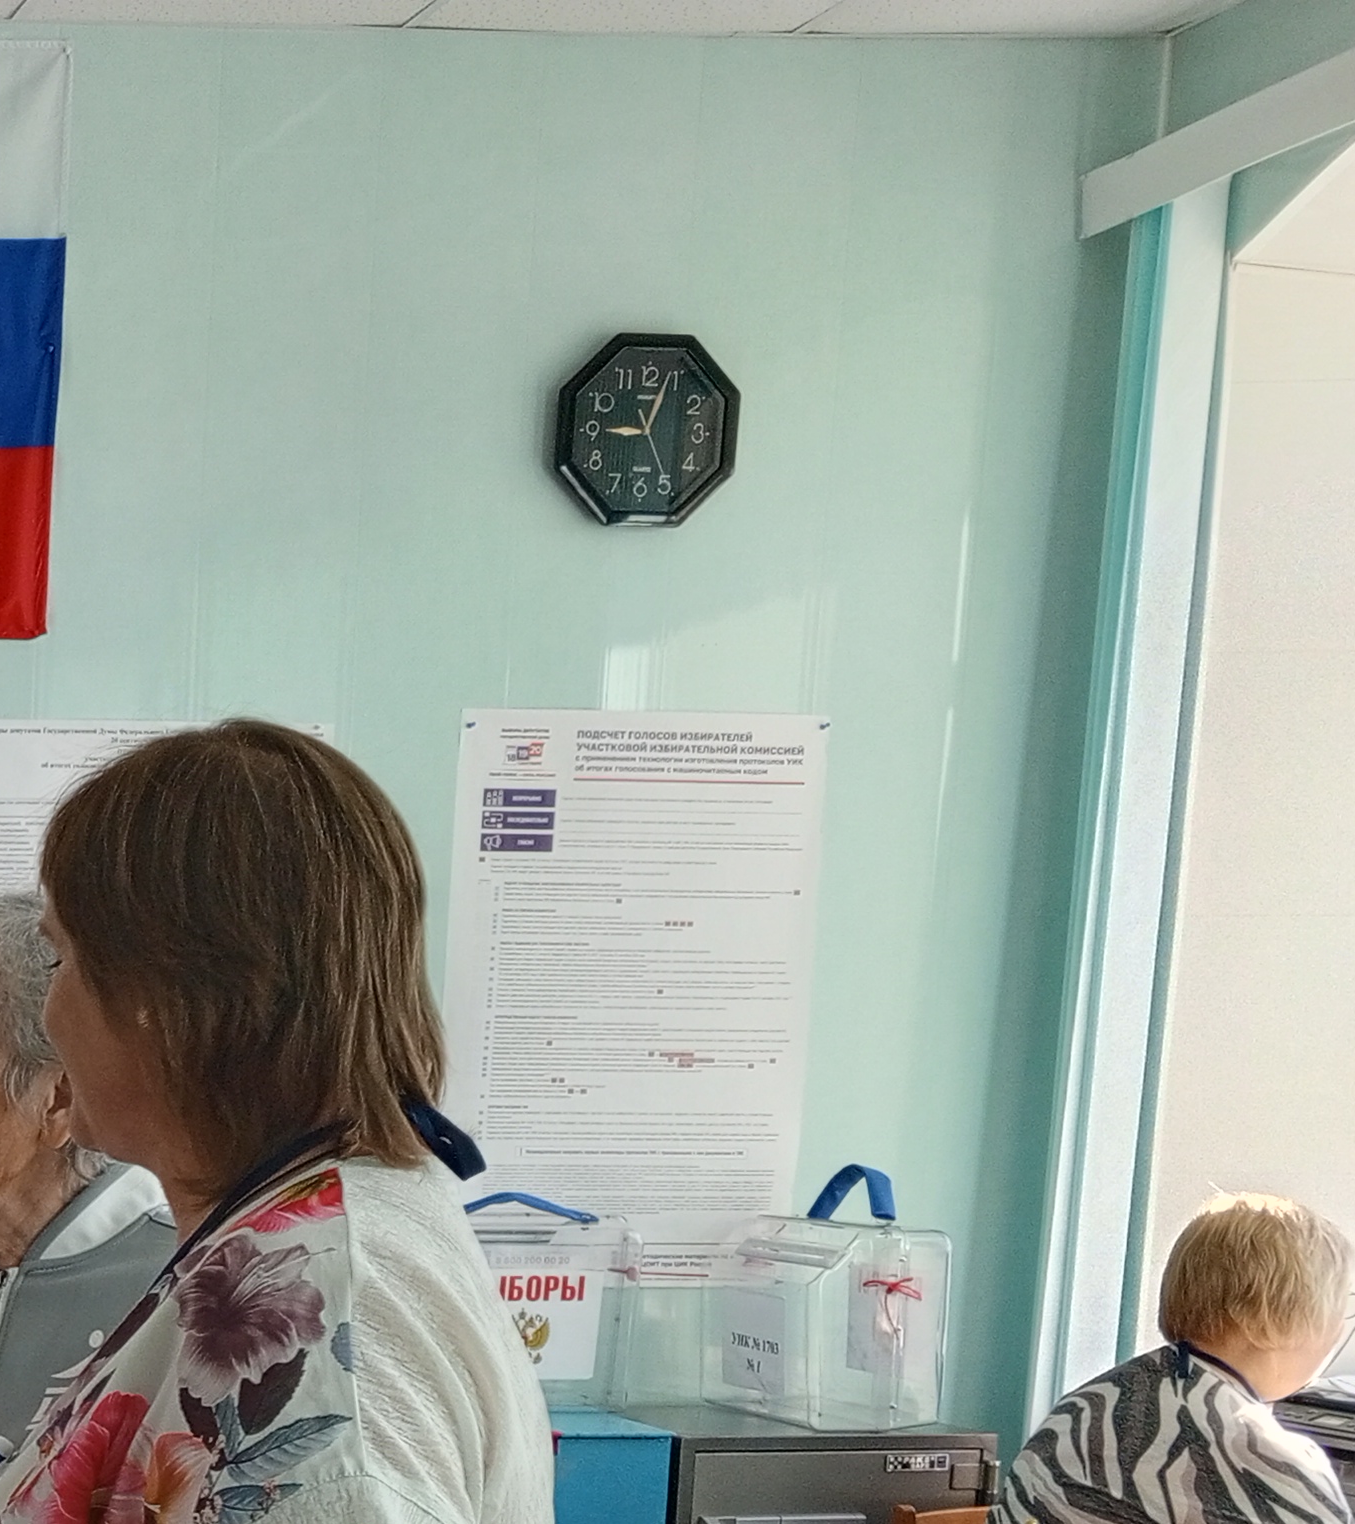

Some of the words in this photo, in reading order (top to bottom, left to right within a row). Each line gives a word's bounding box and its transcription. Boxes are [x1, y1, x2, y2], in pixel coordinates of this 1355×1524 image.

[618, 368, 633, 389] 11
[642, 366, 660, 387] 12
[594, 392, 615, 412] 10
[686, 394, 702, 415] 2
[585, 420, 600, 441] 9
[691, 423, 704, 444] 3
[589, 450, 603, 470] 8
[682, 452, 695, 472] 4
[608, 473, 622, 493] 7
[633, 477, 648, 496] 6
[657, 475, 671, 495] 5
[576, 730, 626, 741] ПОДСЧЕТ
[628, 731, 678, 741] ГОЛОСОВ
[680, 730, 752, 742] ИЗБИРАТЕЛЕЙ
[575, 742, 647, 753] УЧАСТКОВОЙ
[649, 743, 738, 754] ИЗБИРАТЕЛЬНОЙ
[740, 745, 805, 756] КОМИССИЕЙ
[575, 764, 585, 773] об
[499, 1275, 586, 1302] БОРЫ
